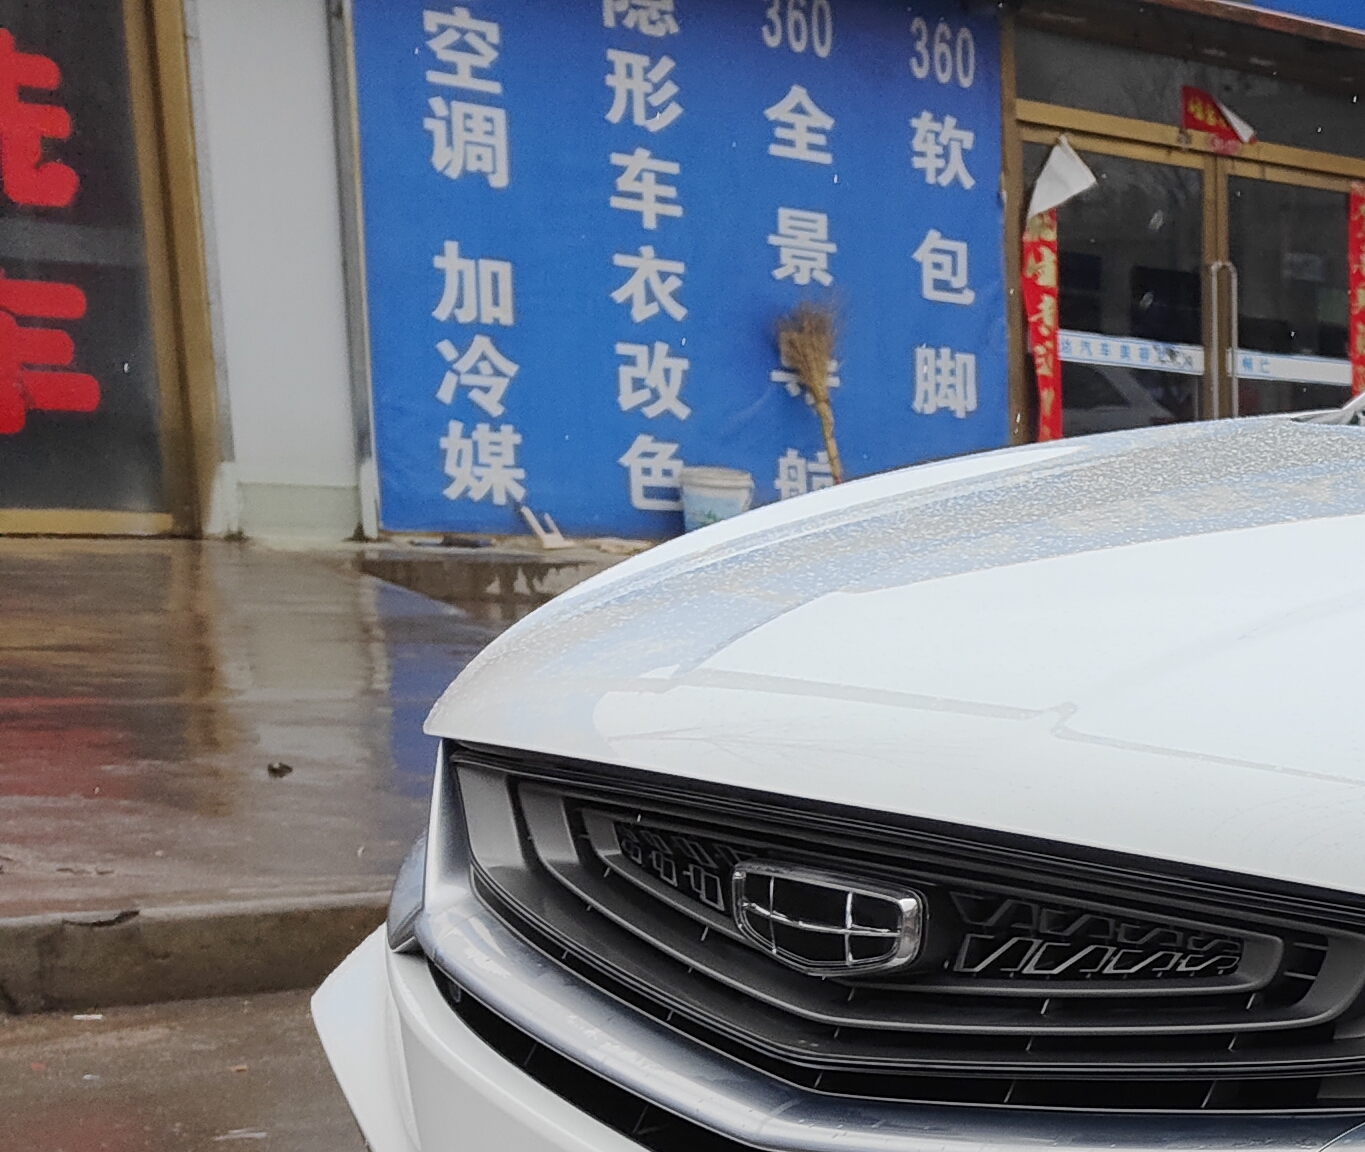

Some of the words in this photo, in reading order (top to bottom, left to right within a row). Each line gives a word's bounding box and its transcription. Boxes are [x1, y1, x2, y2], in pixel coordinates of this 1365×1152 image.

[422, 7, 511, 190] 空调
[431, 240, 526, 507] 加冷媒
